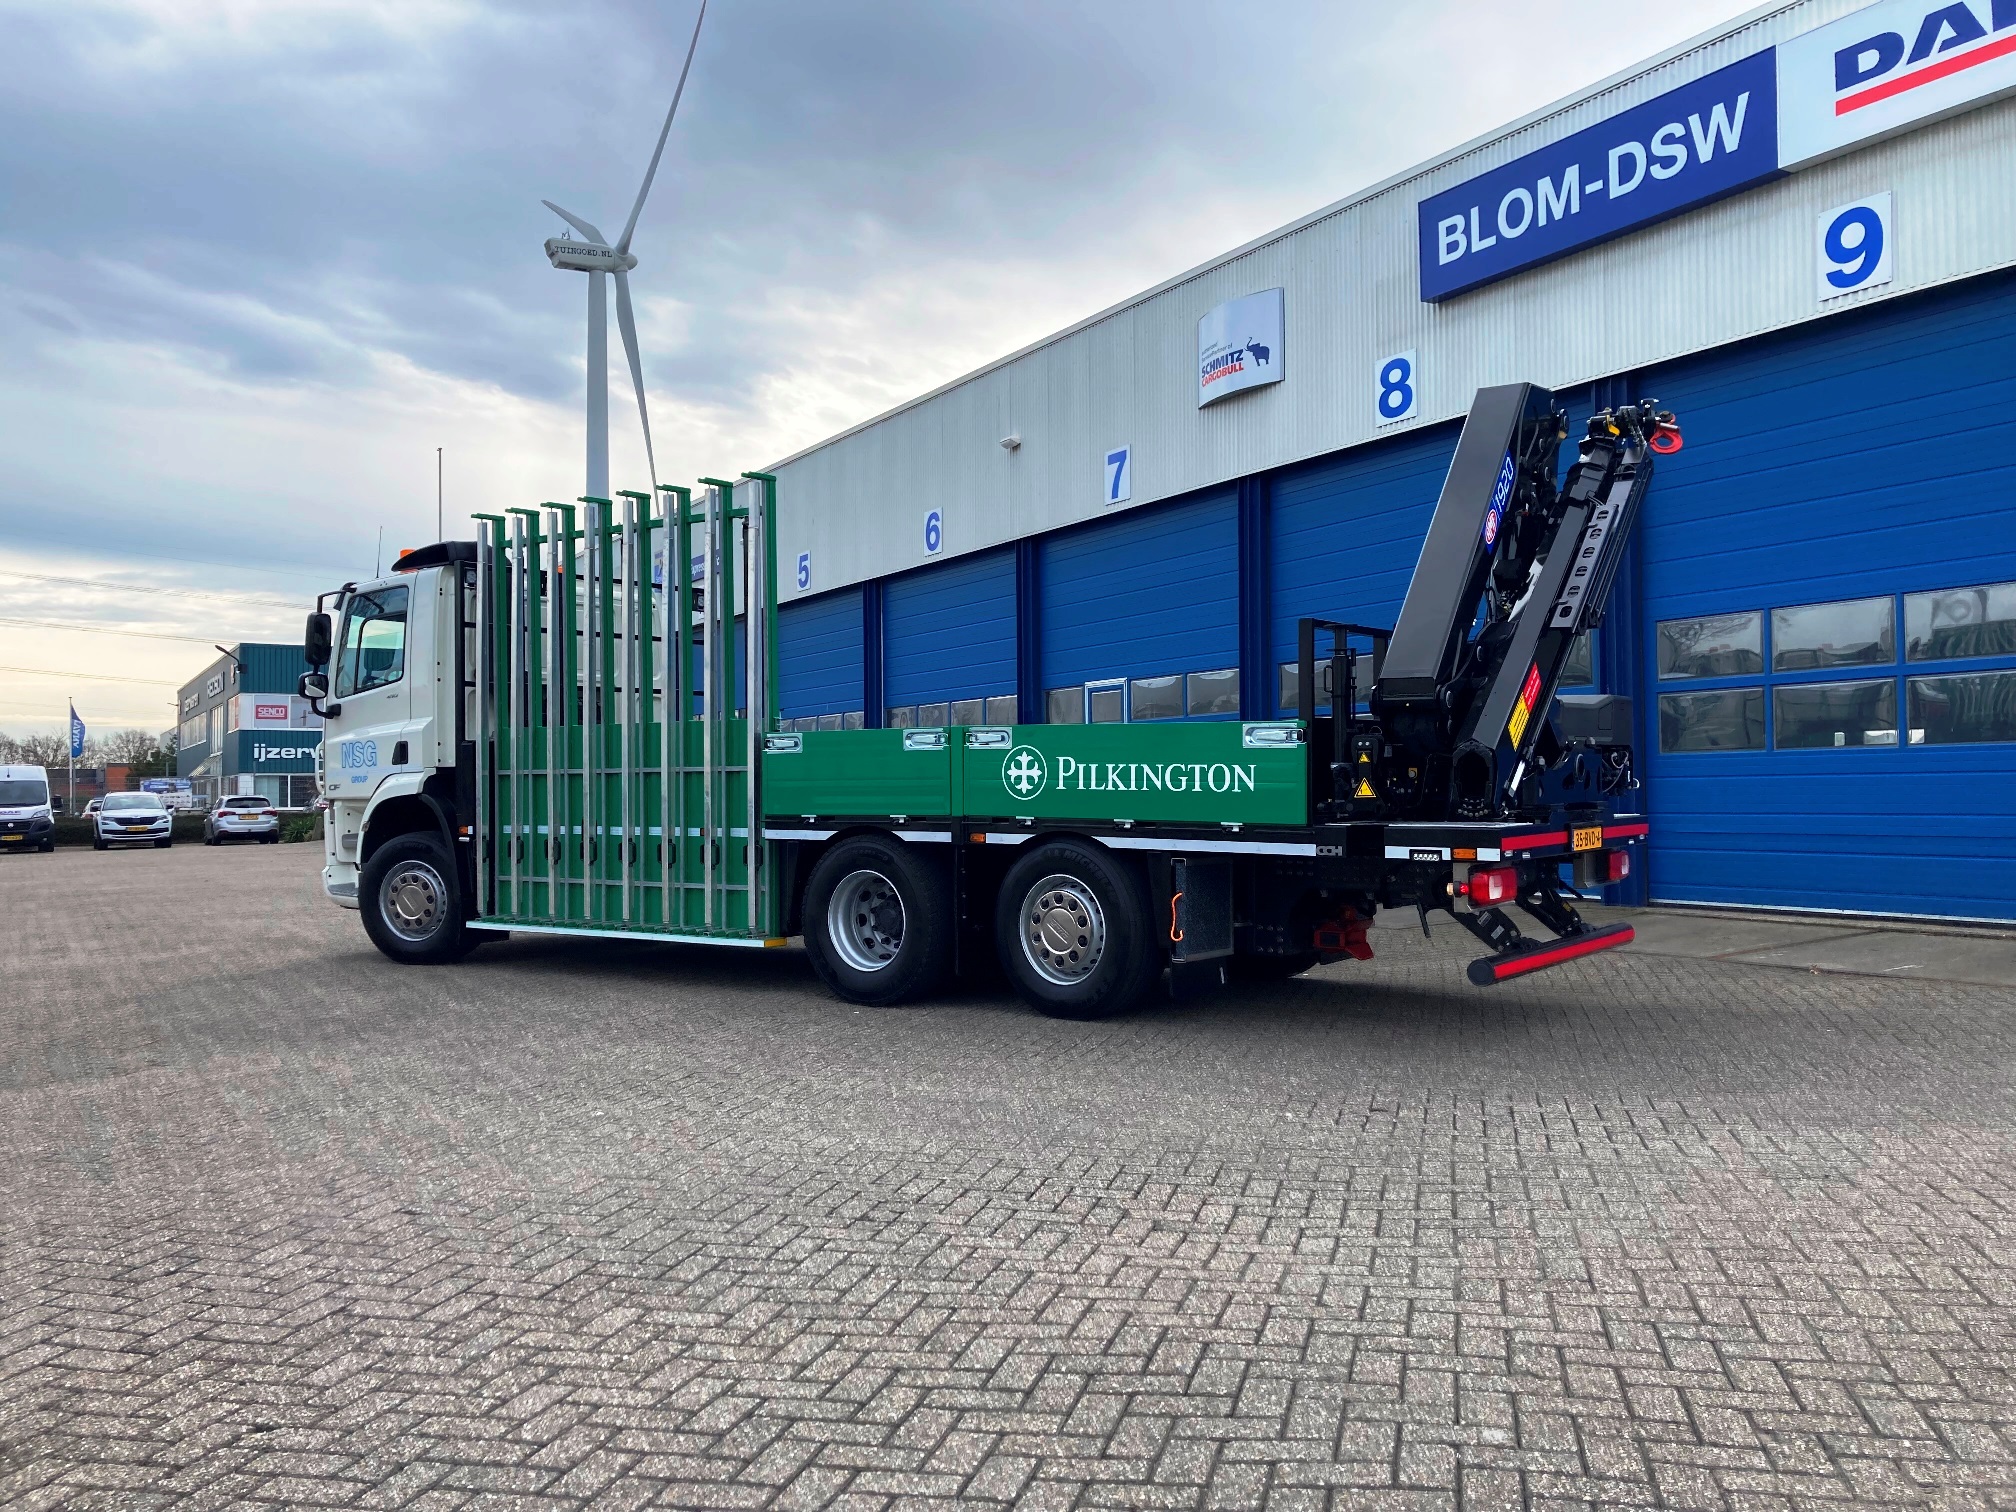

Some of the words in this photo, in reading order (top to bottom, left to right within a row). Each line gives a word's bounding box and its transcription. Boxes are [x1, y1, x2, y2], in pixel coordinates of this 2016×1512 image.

[1437, 91, 1750, 266] BLOM-DSW
[554, 245, 613, 258] TUINGOED.NL
[1824, 206, 1884, 288] 9
[1202, 348, 1244, 378] SCHMITZ
[1202, 362, 1244, 387] CARGOBULL
[1378, 357, 1414, 419] 8
[1107, 449, 1129, 500] 7
[1496, 456, 1513, 512] 1920
[924, 511, 941, 552] 6
[798, 554, 810, 588] 5
[258, 707, 285, 716] SENCO
[341, 740, 377, 768] NSG
[1055, 756, 1257, 792] PILKINGTON
